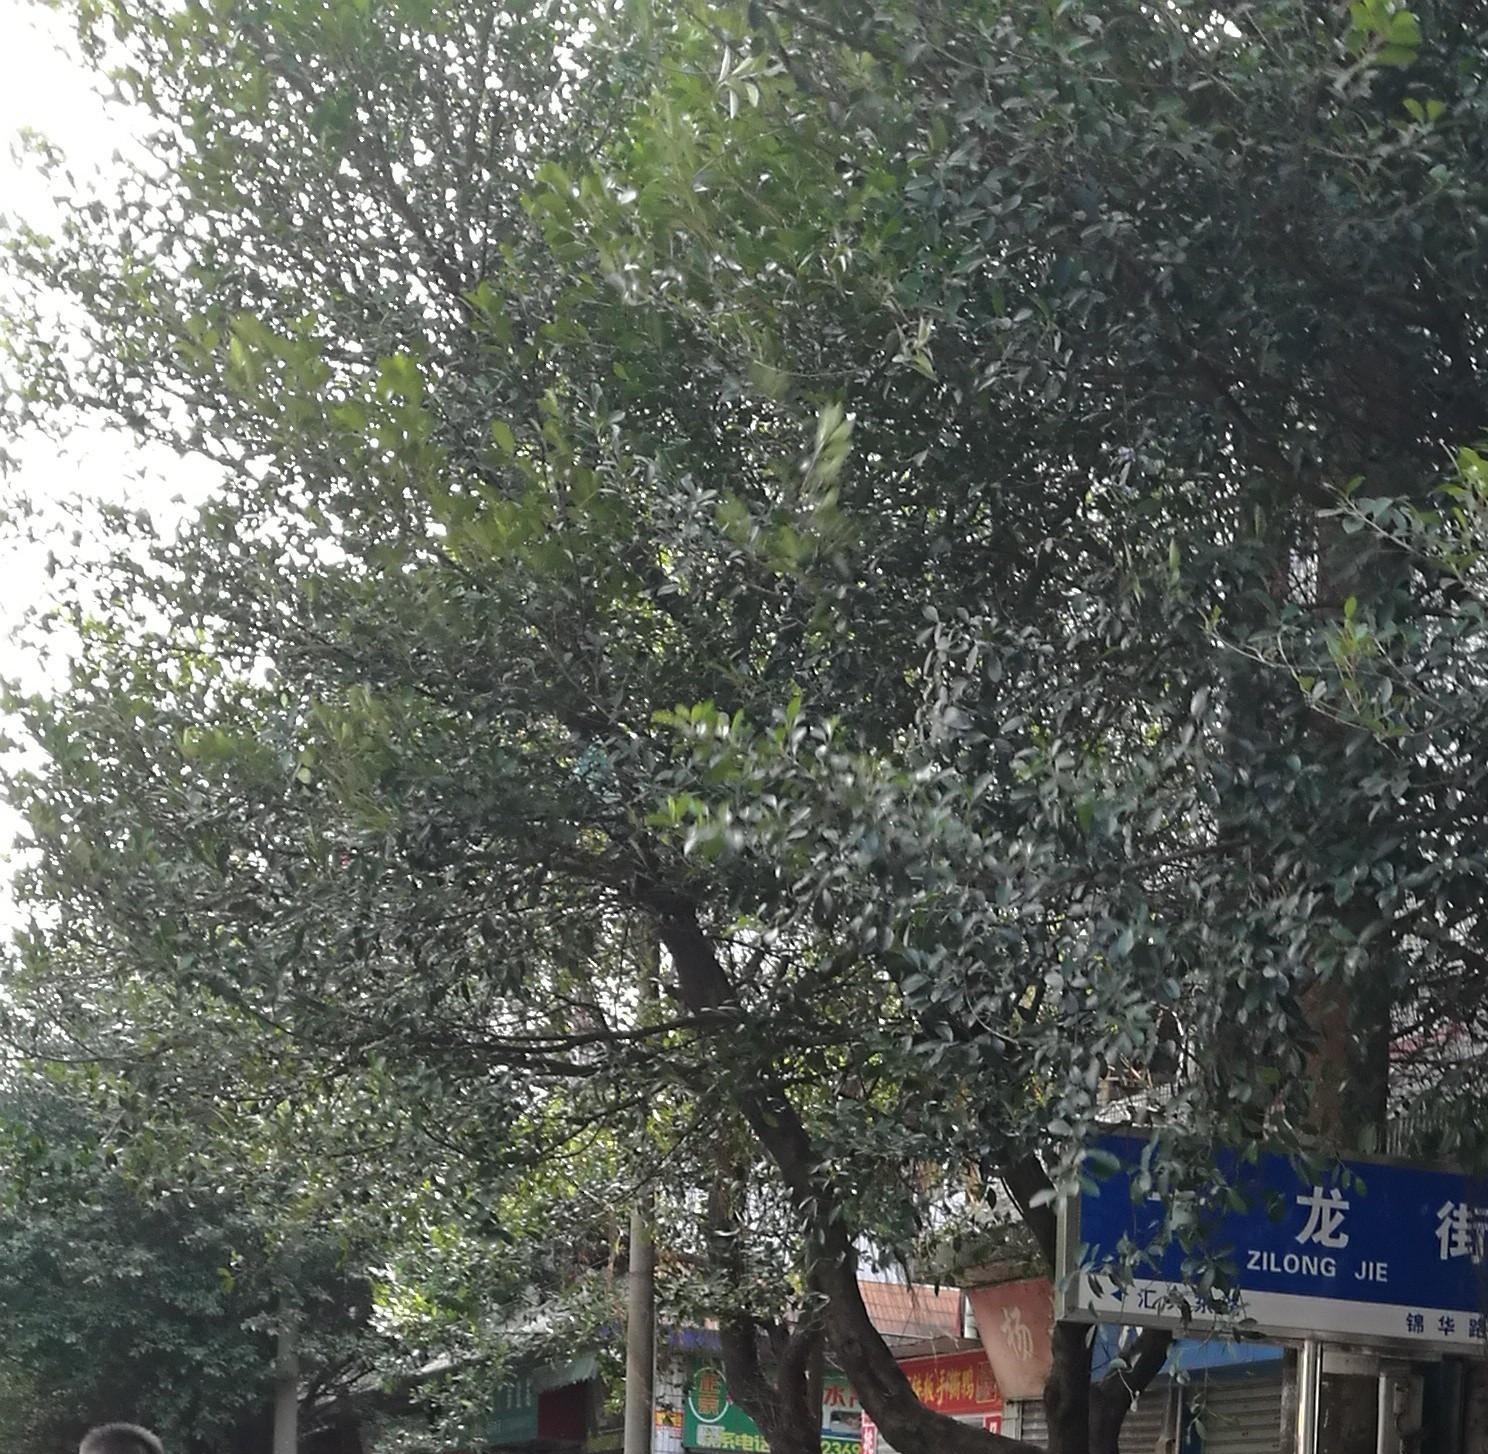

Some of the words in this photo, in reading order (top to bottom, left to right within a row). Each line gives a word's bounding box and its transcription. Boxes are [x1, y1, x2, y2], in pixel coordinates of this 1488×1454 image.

[1148, 1186, 1488, 1265] 龙街
[1246, 1250, 1337, 1278] ZILONG
[1354, 1260, 1389, 1283] JIE
